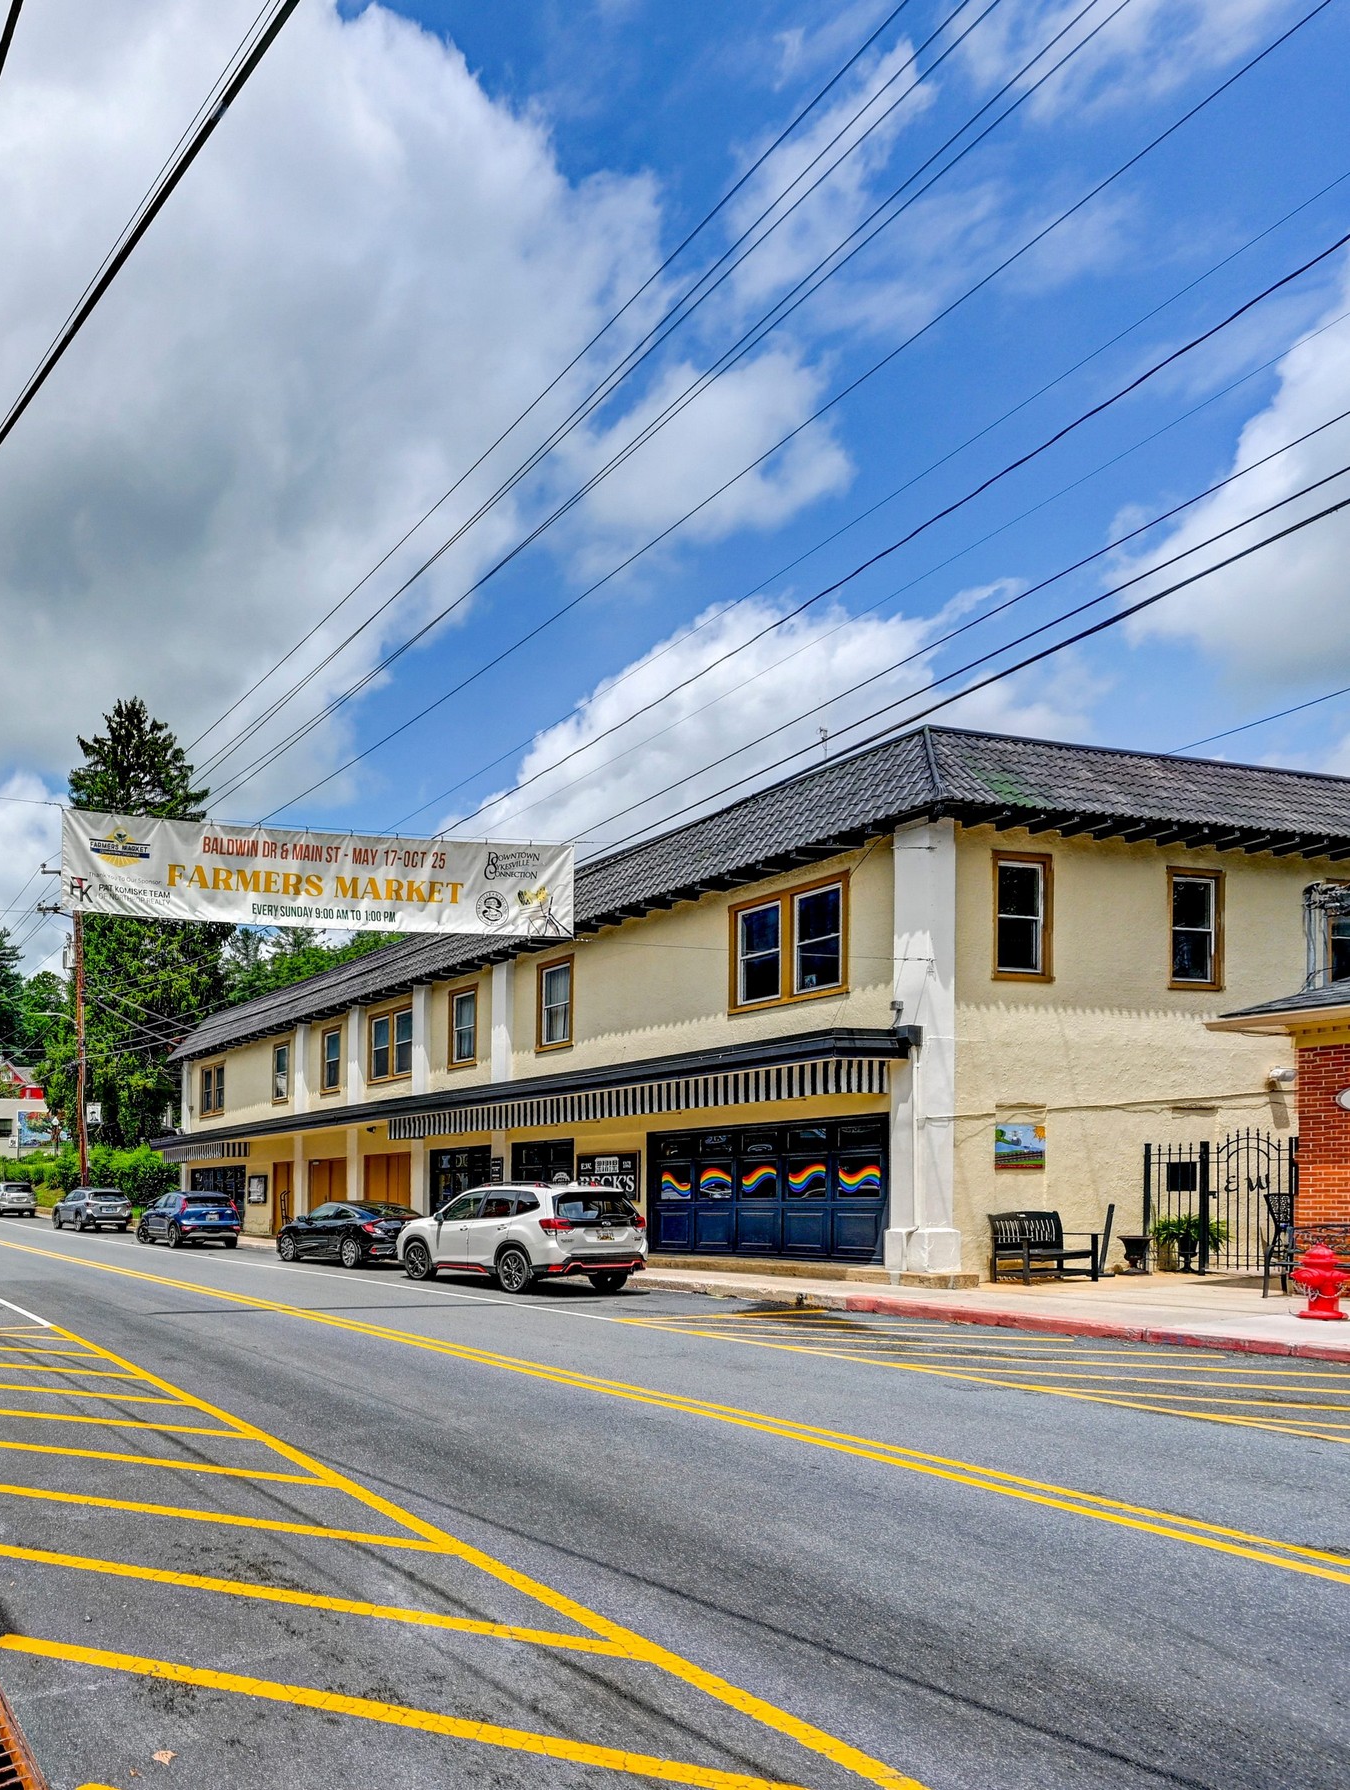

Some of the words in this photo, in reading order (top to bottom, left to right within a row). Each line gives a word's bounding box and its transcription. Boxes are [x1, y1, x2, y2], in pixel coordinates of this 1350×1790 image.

[90, 841, 119, 851] FARMERS
[121, 845, 148, 853] MARKET
[202, 836, 259, 858] BALDWIN
[262, 840, 277, 859] DR
[280, 843, 289, 860] &
[292, 843, 323, 862] MAIN
[325, 846, 341, 863] ST
[352, 847, 378, 866] MAY
[431, 852, 447, 869] 25
[487, 851, 540, 864] DOWNTOWN
[490, 856, 530, 874] SYKESVILLE
[484, 864, 538, 880] CONNECTION
[98, 884, 113, 892] PAT
[115, 886, 148, 896] KOMISKE
[150, 890, 171, 899] TEAM
[166, 863, 324, 897] FARMERS
[334, 875, 464, 904] MARKET
[252, 903, 279, 916] EVERY
[280, 905, 314, 918] SUNDAY
[315, 908, 333, 919] 9:00
[336, 909, 349, 920] AM
[351, 909, 361, 921] TO
[365, 910, 381, 922] 1:00
[384, 911, 396, 922] PM
